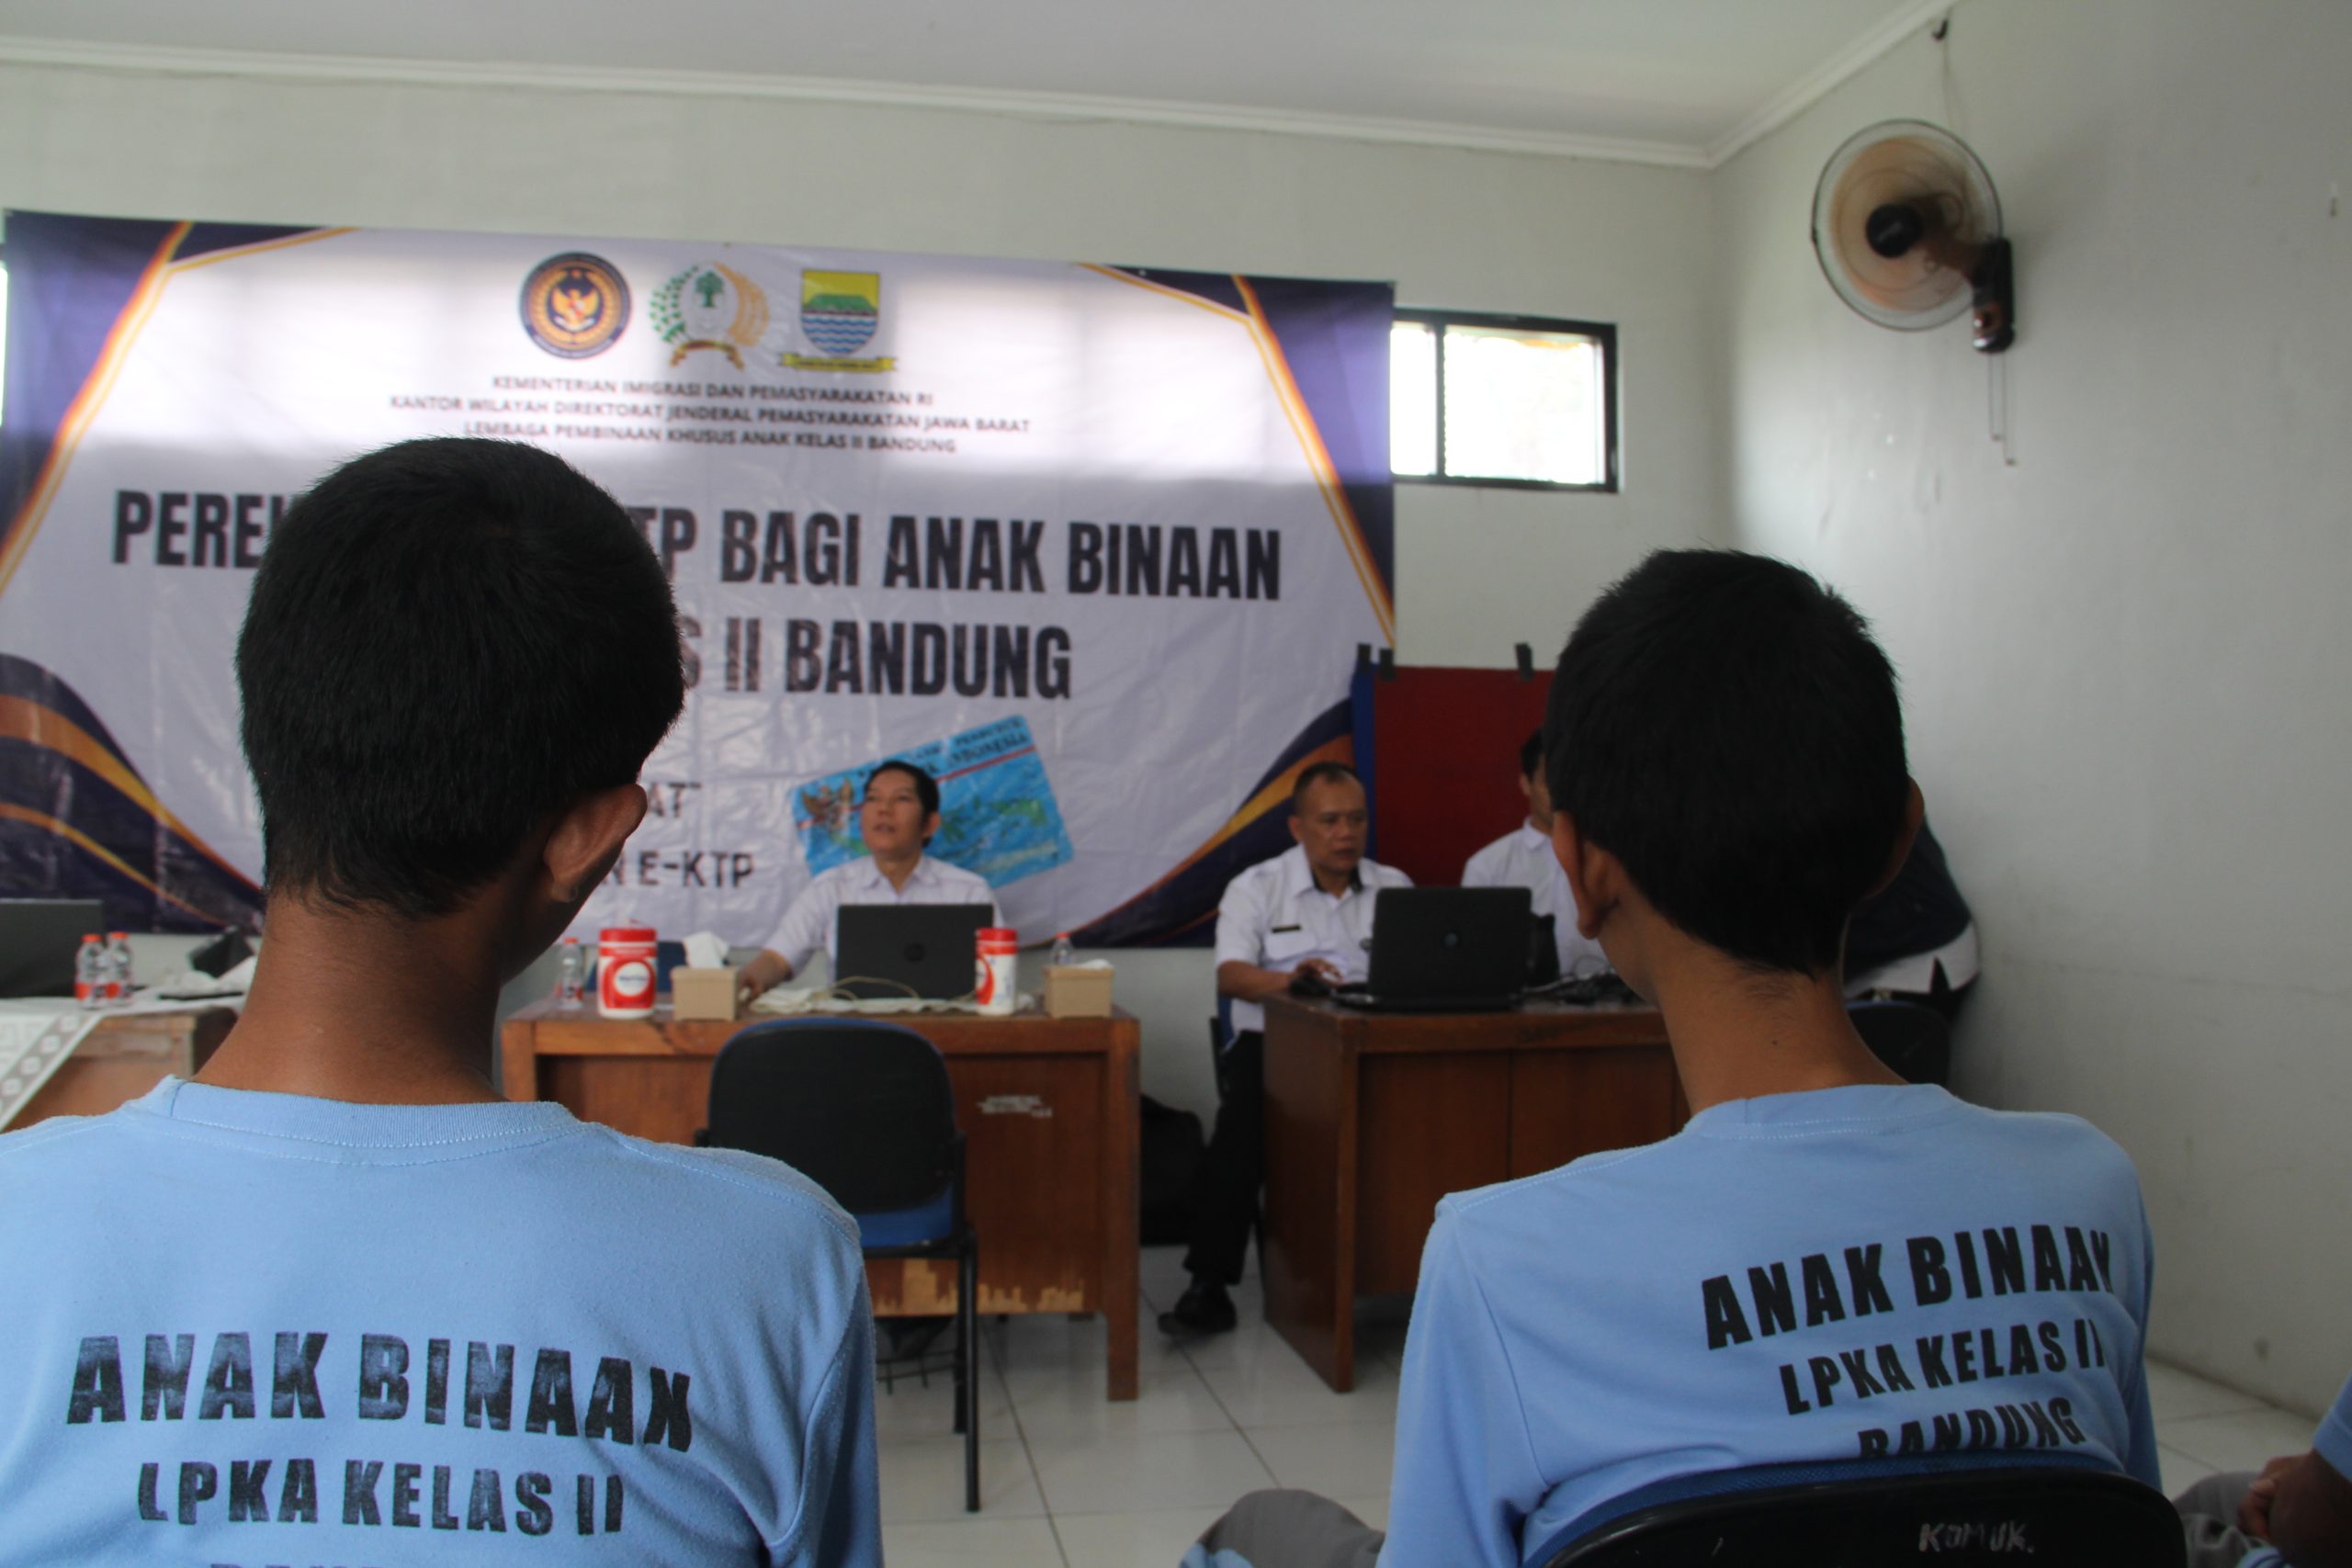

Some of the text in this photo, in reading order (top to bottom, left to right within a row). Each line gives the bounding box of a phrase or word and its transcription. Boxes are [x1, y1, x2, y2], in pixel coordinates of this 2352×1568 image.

[390, 395, 1030, 434] KANTOR WILAYAH DIREKTORAT JENDERAL PEMASYARAKATAN JAWA BARAT
[492, 376, 933, 405] KEMENTERIAN IMIGRASI DAN PEMASYARAKATAN RI
[464, 421, 956, 454] LEMBAGA PEMBINAAN KHUSUS ANAK KELAS II BANDUNG
[719, 509, 861, 587] BAGI
[882, 515, 1046, 592] ANAK
[1067, 522, 1281, 601] BINAAN
[723, 616, 762, 693] II
[785, 618, 1072, 700] BANDUNG
[639, 851, 754, 887] E-KTP
[1702, 1224, 2114, 1349] ANAK BINAAN
[66, 1332, 692, 1452] ANAK BINAAN
[1780, 1319, 2105, 1415] LPKA KELAS II
[1858, 1396, 2086, 1459] BANDUNG
[138, 1458, 624, 1537] LPKA KELAS II
